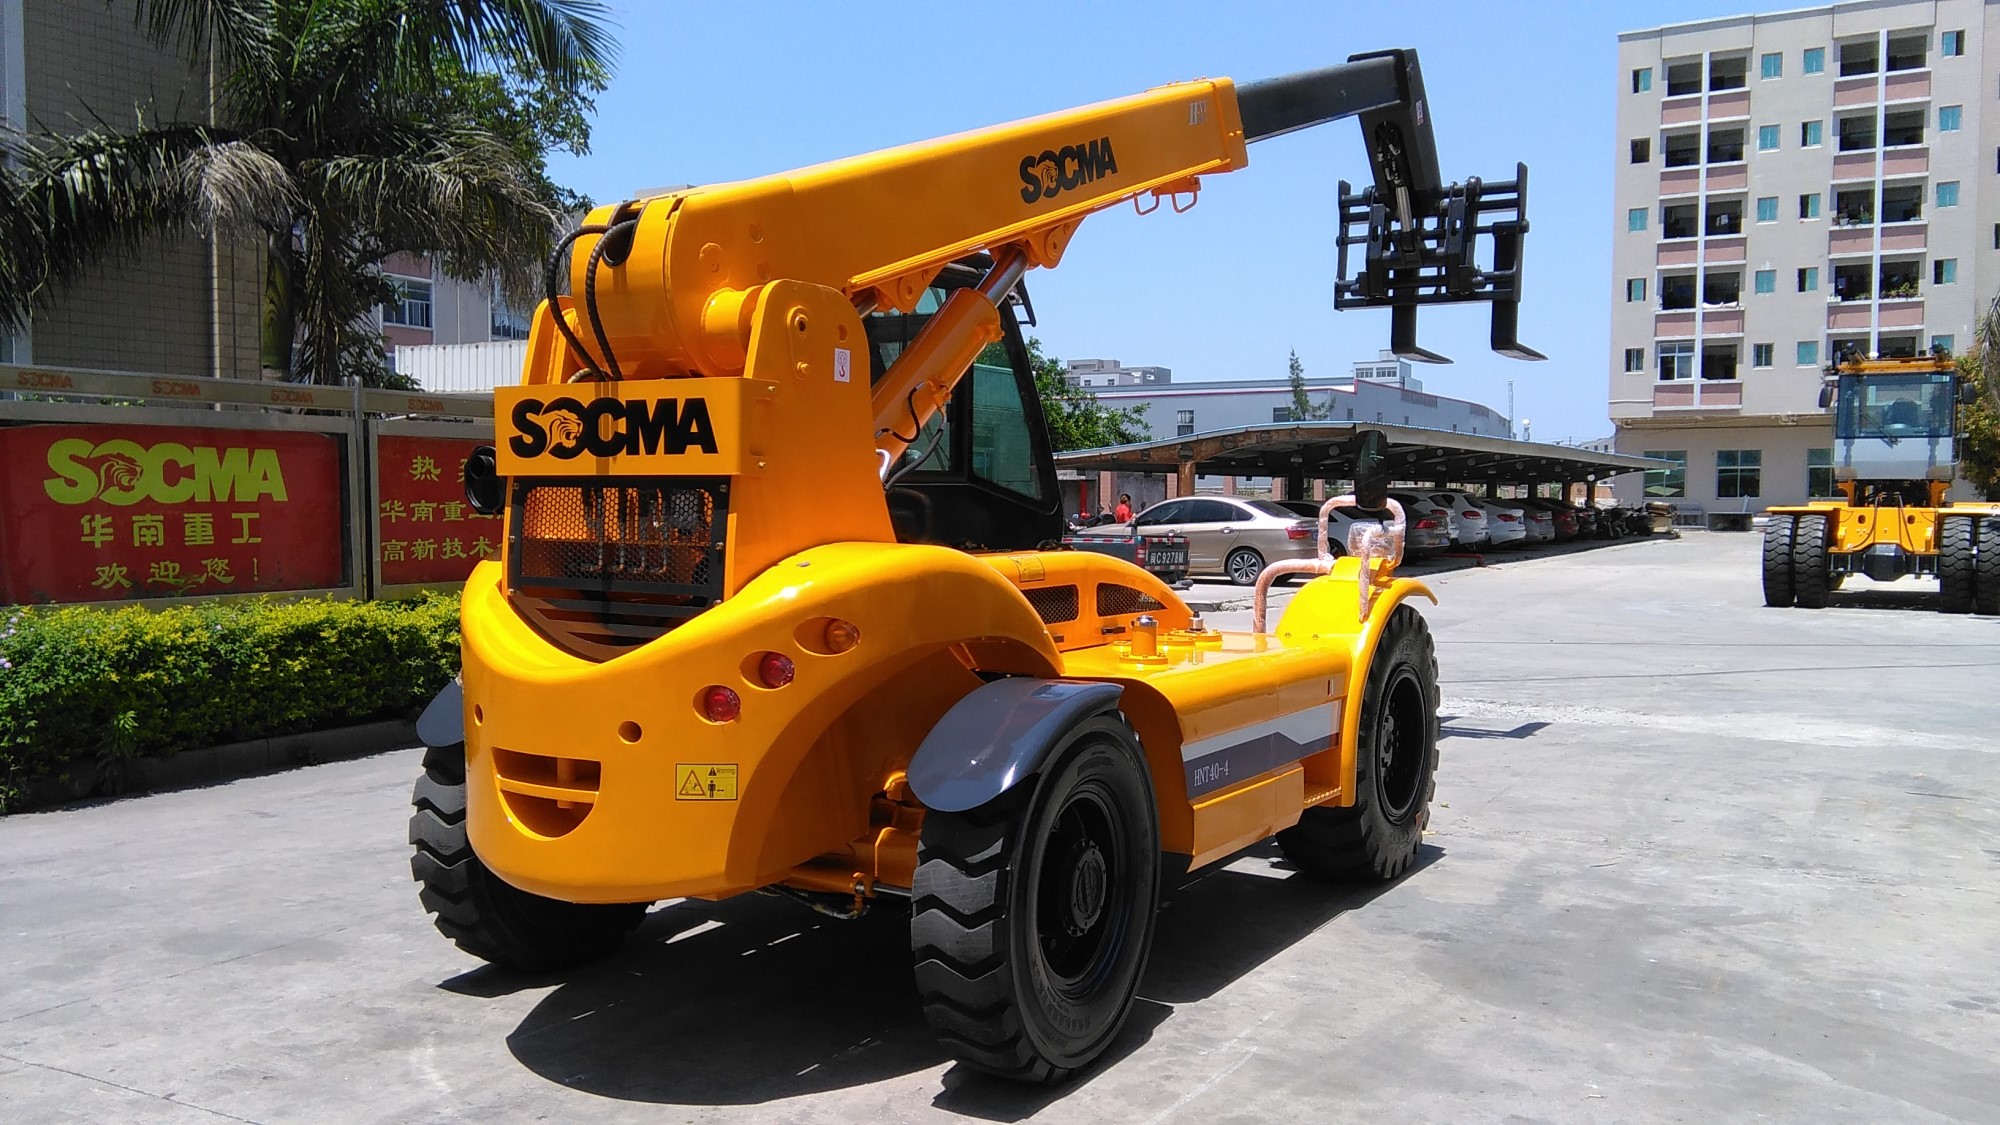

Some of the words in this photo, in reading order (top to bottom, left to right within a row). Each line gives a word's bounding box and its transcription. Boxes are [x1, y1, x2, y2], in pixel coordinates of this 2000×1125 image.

[1019, 136, 1118, 204] SOCMA
[17, 371, 73, 389] SOCMA
[152, 380, 200, 396] SOCMA
[508, 397, 719, 460] SOCMA
[43, 438, 288, 505] SOCMA
[80, 512, 262, 549] 华南重工
[381, 536, 504, 562] 高新技术
[1193, 759, 1230, 787] HNT40-4
